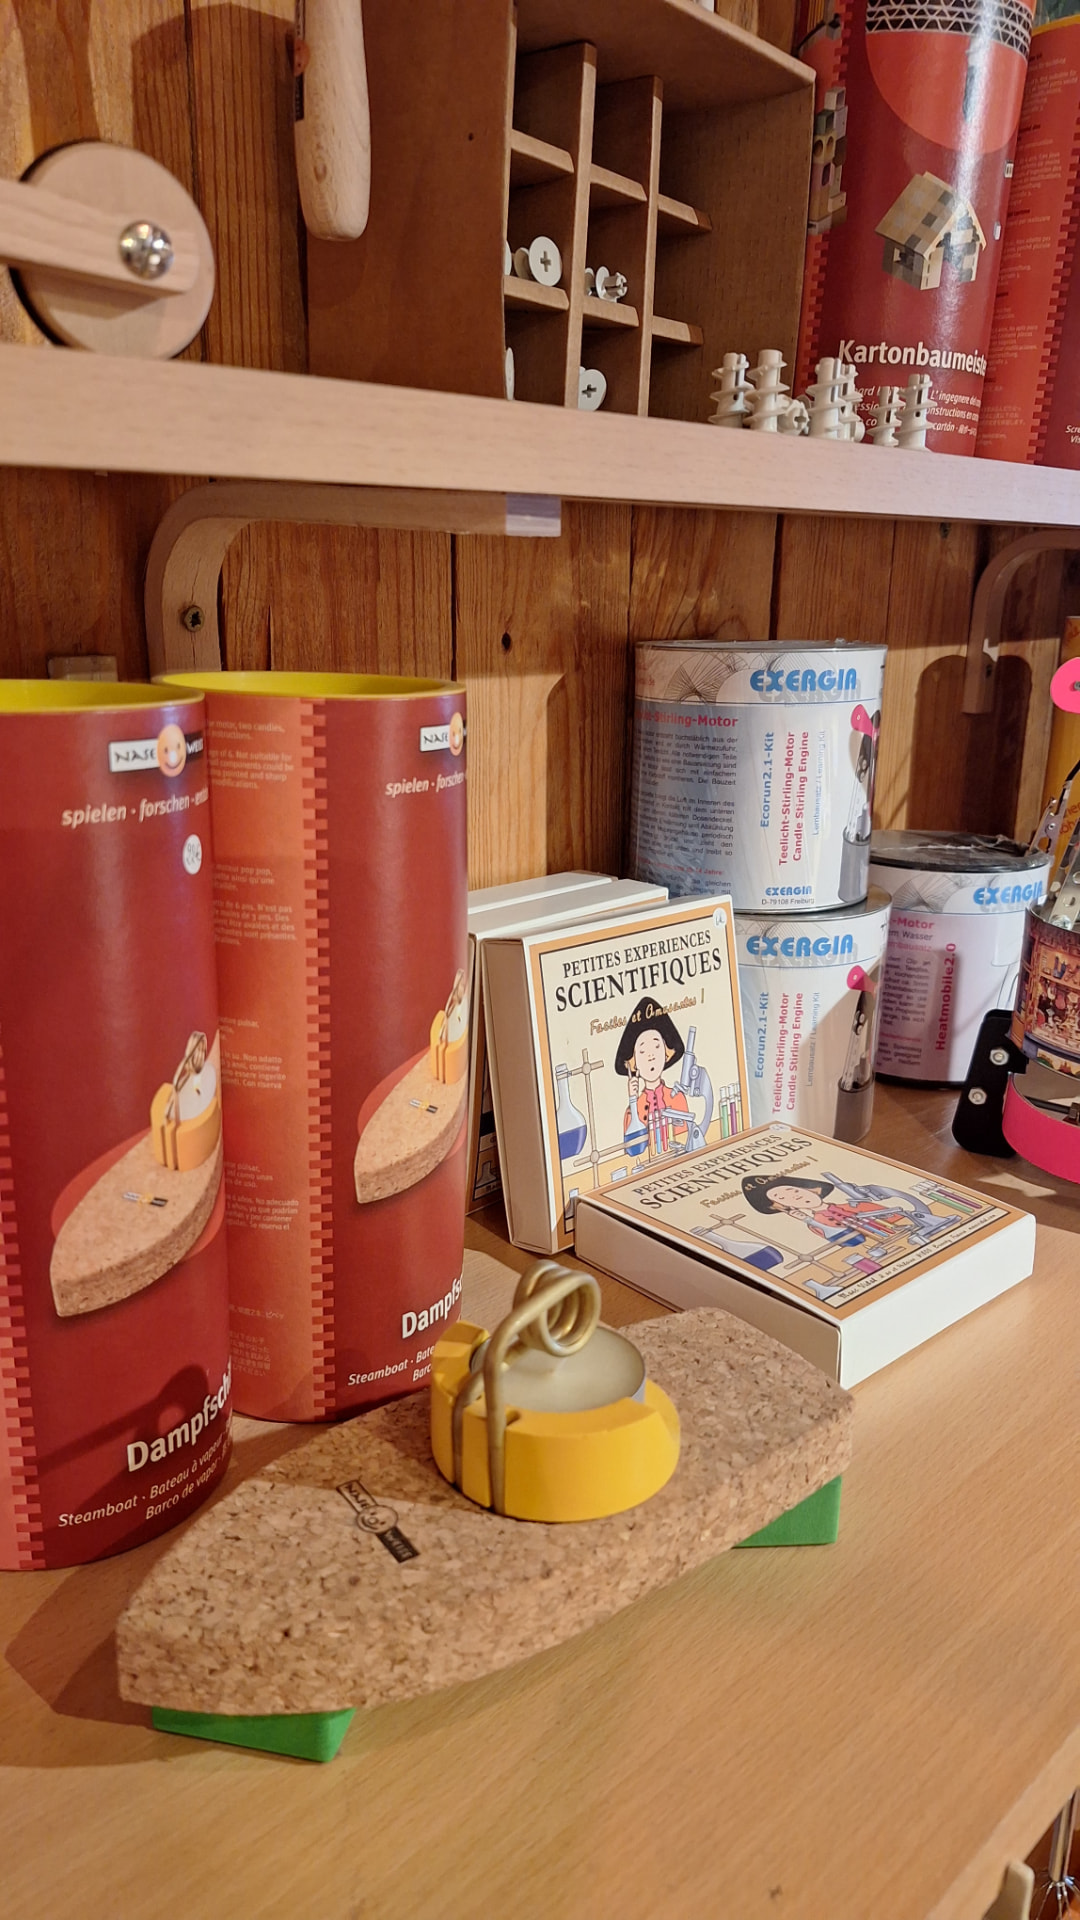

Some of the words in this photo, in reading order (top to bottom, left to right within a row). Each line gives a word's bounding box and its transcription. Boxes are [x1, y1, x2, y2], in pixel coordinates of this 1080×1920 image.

[750, 668, 857, 692] EXERGIA
[114, 747, 157, 764] NASE
[799, 731, 809, 772] Engine
[384, 777, 429, 799] spielen
[711, 778, 737, 786] Bauzeit
[760, 731, 775, 829] Ecorun2.1-Kit
[778, 731, 796, 867] Teelicht-Stirling-Motor
[796, 775, 808, 821] Stirling
[61, 803, 127, 830] spielen
[139, 793, 190, 822] forschen
[792, 822, 804, 862] Candle
[765, 885, 813, 897] EXERGIA
[973, 880, 1043, 906] EXERGIA
[562, 950, 621, 979] PETITES
[624, 930, 712, 965] EXPERIENCES
[746, 934, 854, 958] EXERGIA
[902, 930, 934, 941] Wasser
[555, 947, 722, 1013] SCIENTIFIQUES
[935, 943, 957, 1051] Heatmobile2.0
[589, 1015, 627, 1036] Faciles
[631, 1009, 642, 1023] et
[792, 992, 804, 1029] Engine
[755, 991, 770, 1079] Ecorun2.1-Kit
[772, 992, 790, 1115] Teelicht-Stirling-Motor
[789, 1029, 801, 1073] Stirling
[786, 1073, 797, 1111] Candle
[632, 1169, 693, 1197] PETITES
[691, 1134, 784, 1177] EXPERIENCES
[639, 1137, 814, 1210] SCIENTIFIQUES
[347, 1358, 409, 1386] Steamboat
[416, 1345, 435, 1363] Bate
[412, 1363, 432, 1382] Barc
[58, 1494, 139, 1527] Steamboat
[150, 1468, 189, 1500] Bateau
[191, 1459, 198, 1473] à
[199, 1432, 223, 1467] vapeur
[146, 1493, 180, 1520] Barco
[181, 1482, 194, 1499] de
[196, 1459, 220, 1487] vapor
